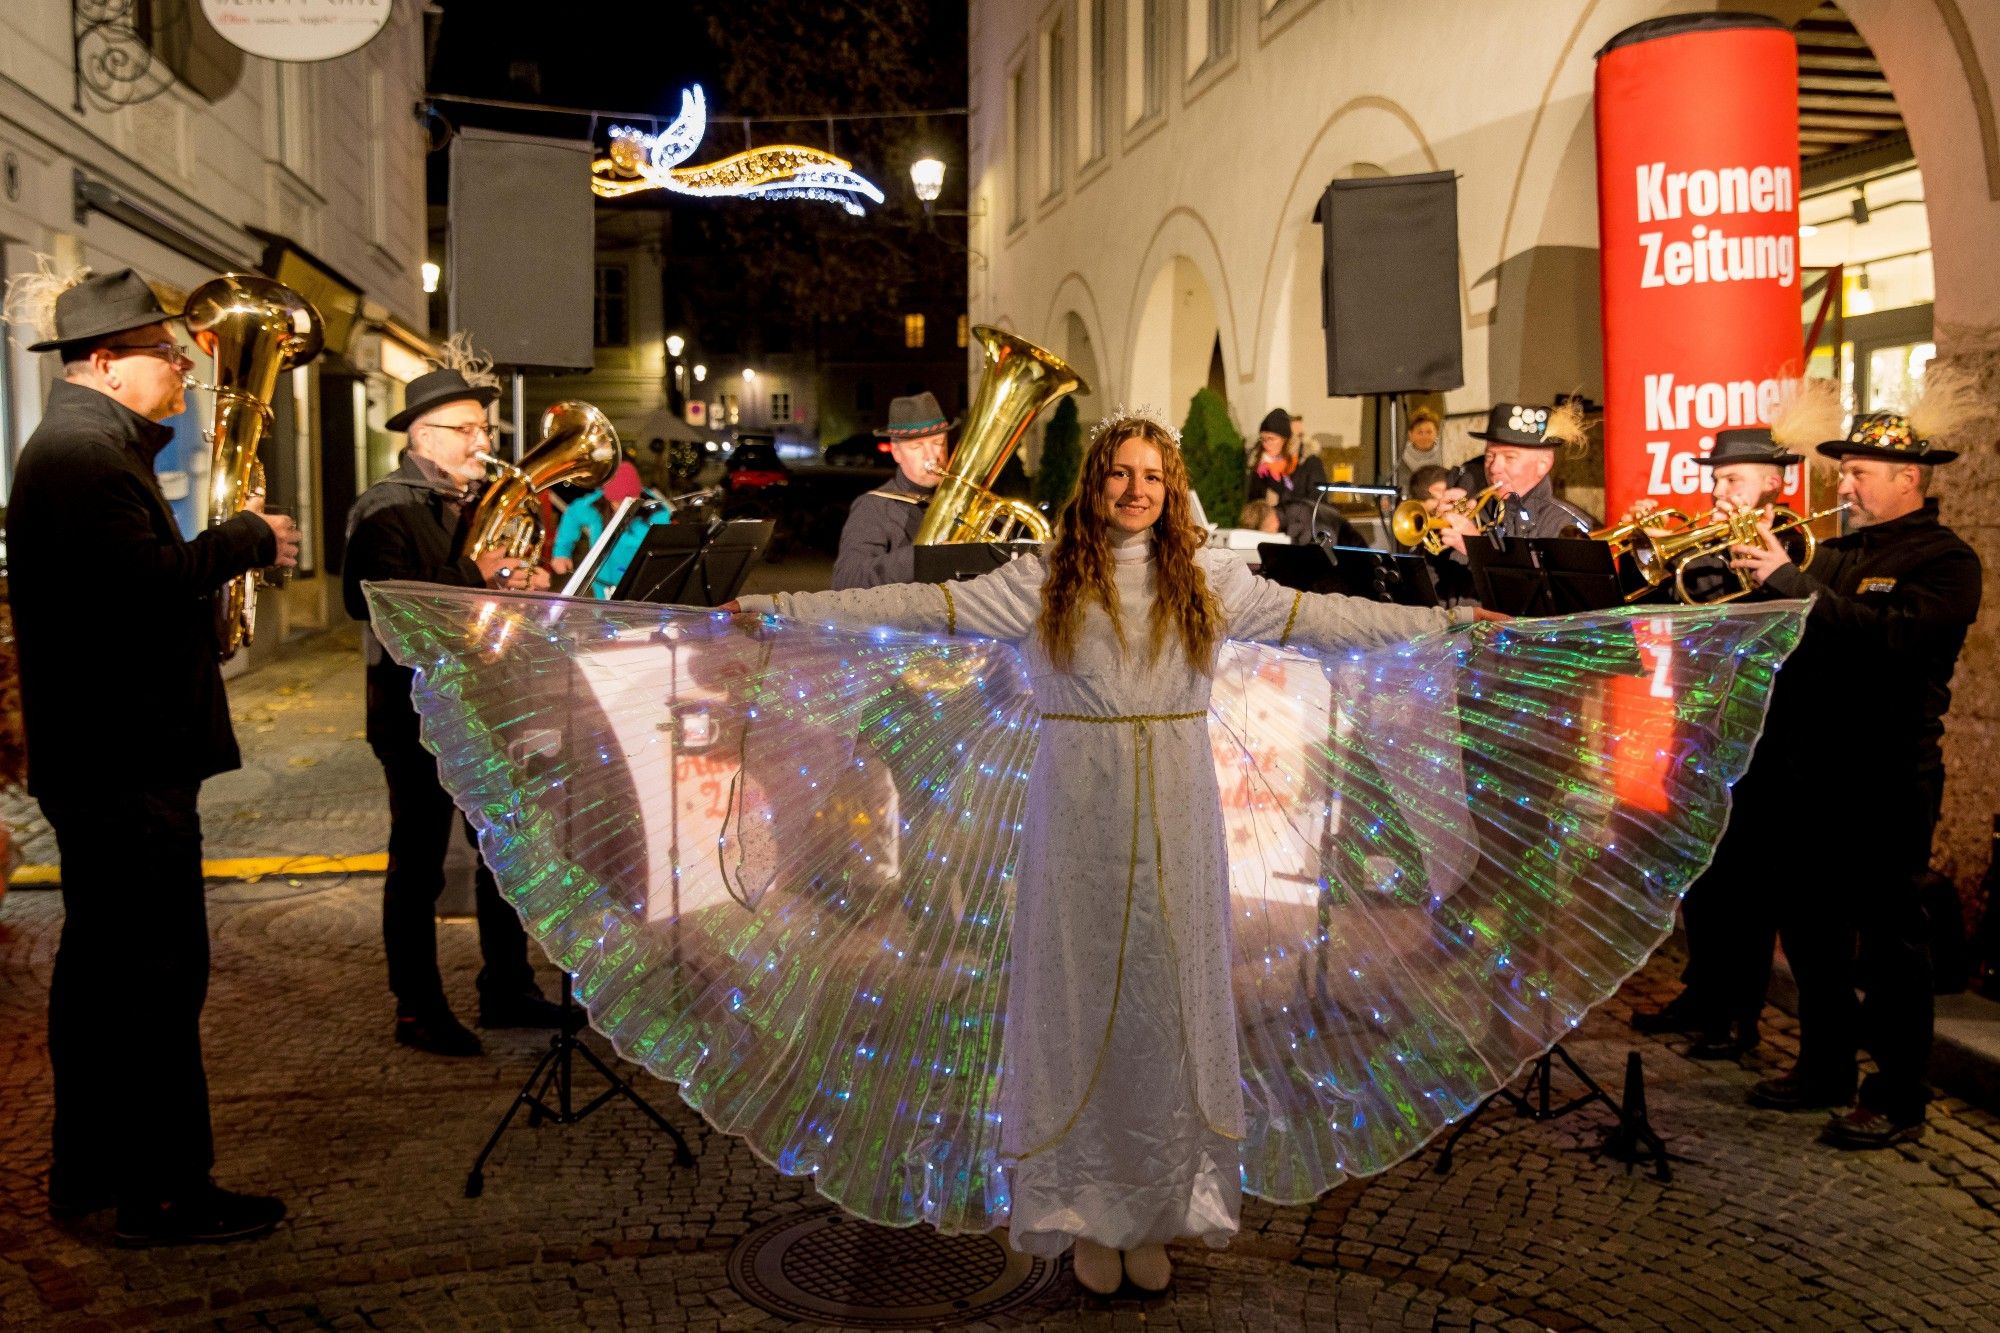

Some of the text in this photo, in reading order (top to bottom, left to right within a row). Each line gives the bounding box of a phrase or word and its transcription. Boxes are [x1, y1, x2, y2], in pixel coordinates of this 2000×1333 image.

[1636, 162, 1793, 223] Kronen
[1639, 225, 1795, 288] Zeitung
[1646, 436, 1799, 496] Zeig
